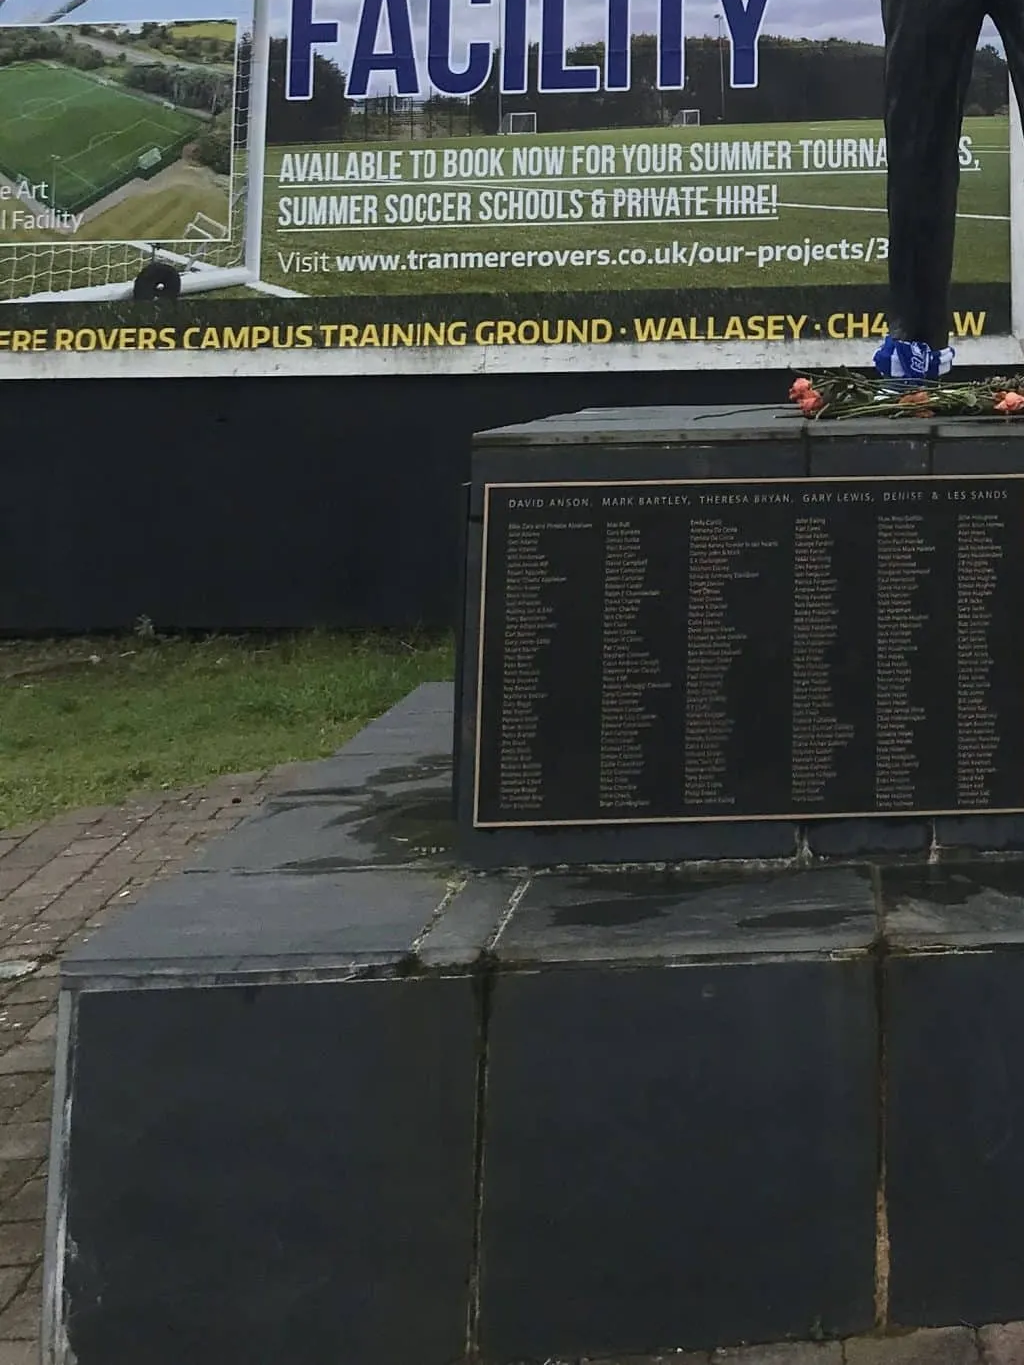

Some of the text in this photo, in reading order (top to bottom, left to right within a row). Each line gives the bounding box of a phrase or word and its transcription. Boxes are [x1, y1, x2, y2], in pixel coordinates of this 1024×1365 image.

[279, 151, 402, 182] AVAILABLE
[410, 150, 436, 179] TO
[443, 147, 504, 177] BOOK
[512, 146, 565, 175] NOW
[572, 145, 615, 174] FOR
[622, 143, 682, 173] YOUR
[690, 141, 792, 172] SUMMER
[16, 180, 49, 199] Art
[278, 184, 778, 226] SUMMER SOCCER SCHOOLS & PRIVATE HIRE!
[12, 210, 85, 234] Facility
[278, 237, 889, 273] Visit www.tranmererovers.co.uk/our-projects/3
[55, 327, 176, 351] ROVERS
[183, 324, 313, 350] CAMPUS
[320, 321, 467, 348] TRAINING
[475, 318, 612, 347] GROUND
[634, 314, 808, 342] WALLASEY
[828, 312, 889, 338] CH4
[508, 497, 544, 509] DAVID
[602, 496, 633, 507] MARK
[700, 494, 749, 506] THERESA
[802, 493, 832, 504] GARY
[883, 491, 923, 502] DENISE
[931, 491, 939, 501] &
[947, 490, 968, 501] LES
[971, 490, 1008, 501] SANDS
